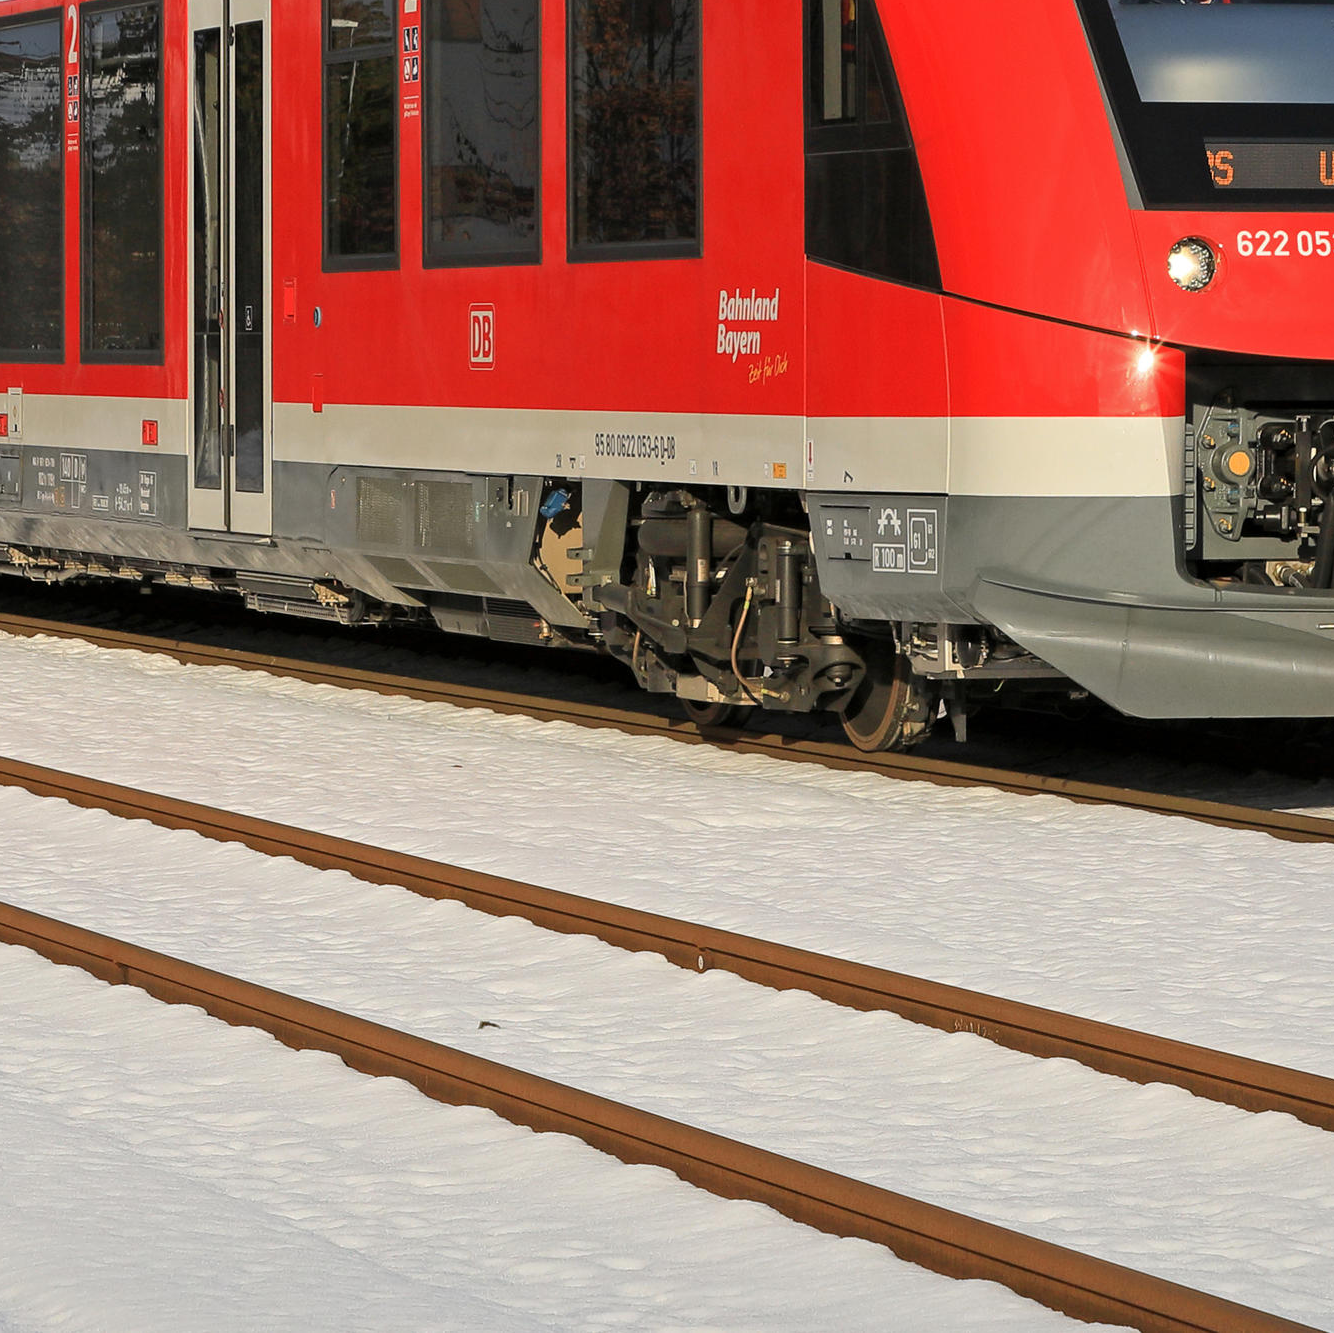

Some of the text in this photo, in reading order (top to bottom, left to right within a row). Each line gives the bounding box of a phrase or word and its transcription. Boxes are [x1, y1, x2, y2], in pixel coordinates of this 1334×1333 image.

[67, 3, 78, 64] 2
[1236, 229, 1291, 257] 622
[718, 287, 780, 321] Bahnland
[472, 315, 492, 358] DB
[716, 323, 761, 363] Bayern
[595, 432, 605, 456] 95
[606, 433, 616, 457] 80
[617, 434, 635, 458] 0622
[637, 435, 659, 459] 053-6
[875, 548, 880, 567] R
[882, 548, 896, 568] 100
